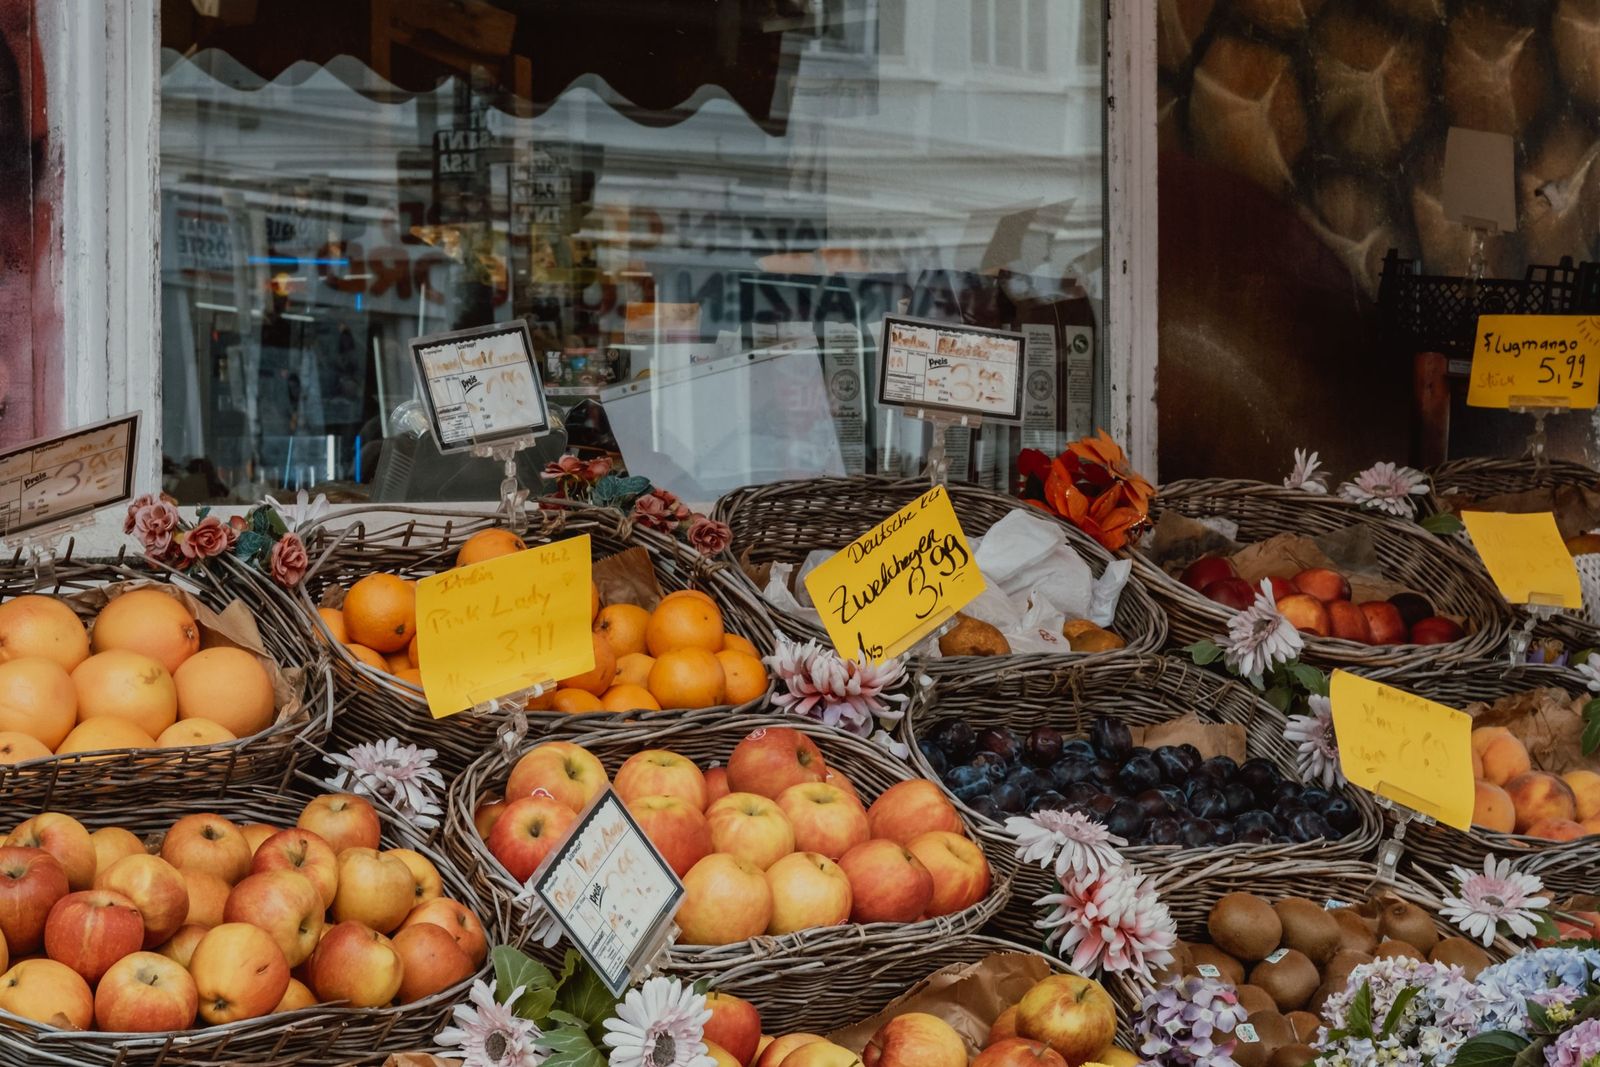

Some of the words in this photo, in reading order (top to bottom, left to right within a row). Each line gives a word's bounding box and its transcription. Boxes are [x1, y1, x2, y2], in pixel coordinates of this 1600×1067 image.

[1482, 331, 1579, 358] Flugmango
[928, 357, 949, 368] Preis
[1537, 353, 1587, 384] 5,99
[461, 374, 478, 391] Preis
[23, 472, 48, 489] Preis
[848, 511, 917, 564] Deutsche
[908, 533, 969, 620] 3,99
[489, 583, 551, 617] Lady
[589, 881, 603, 907] Preis
